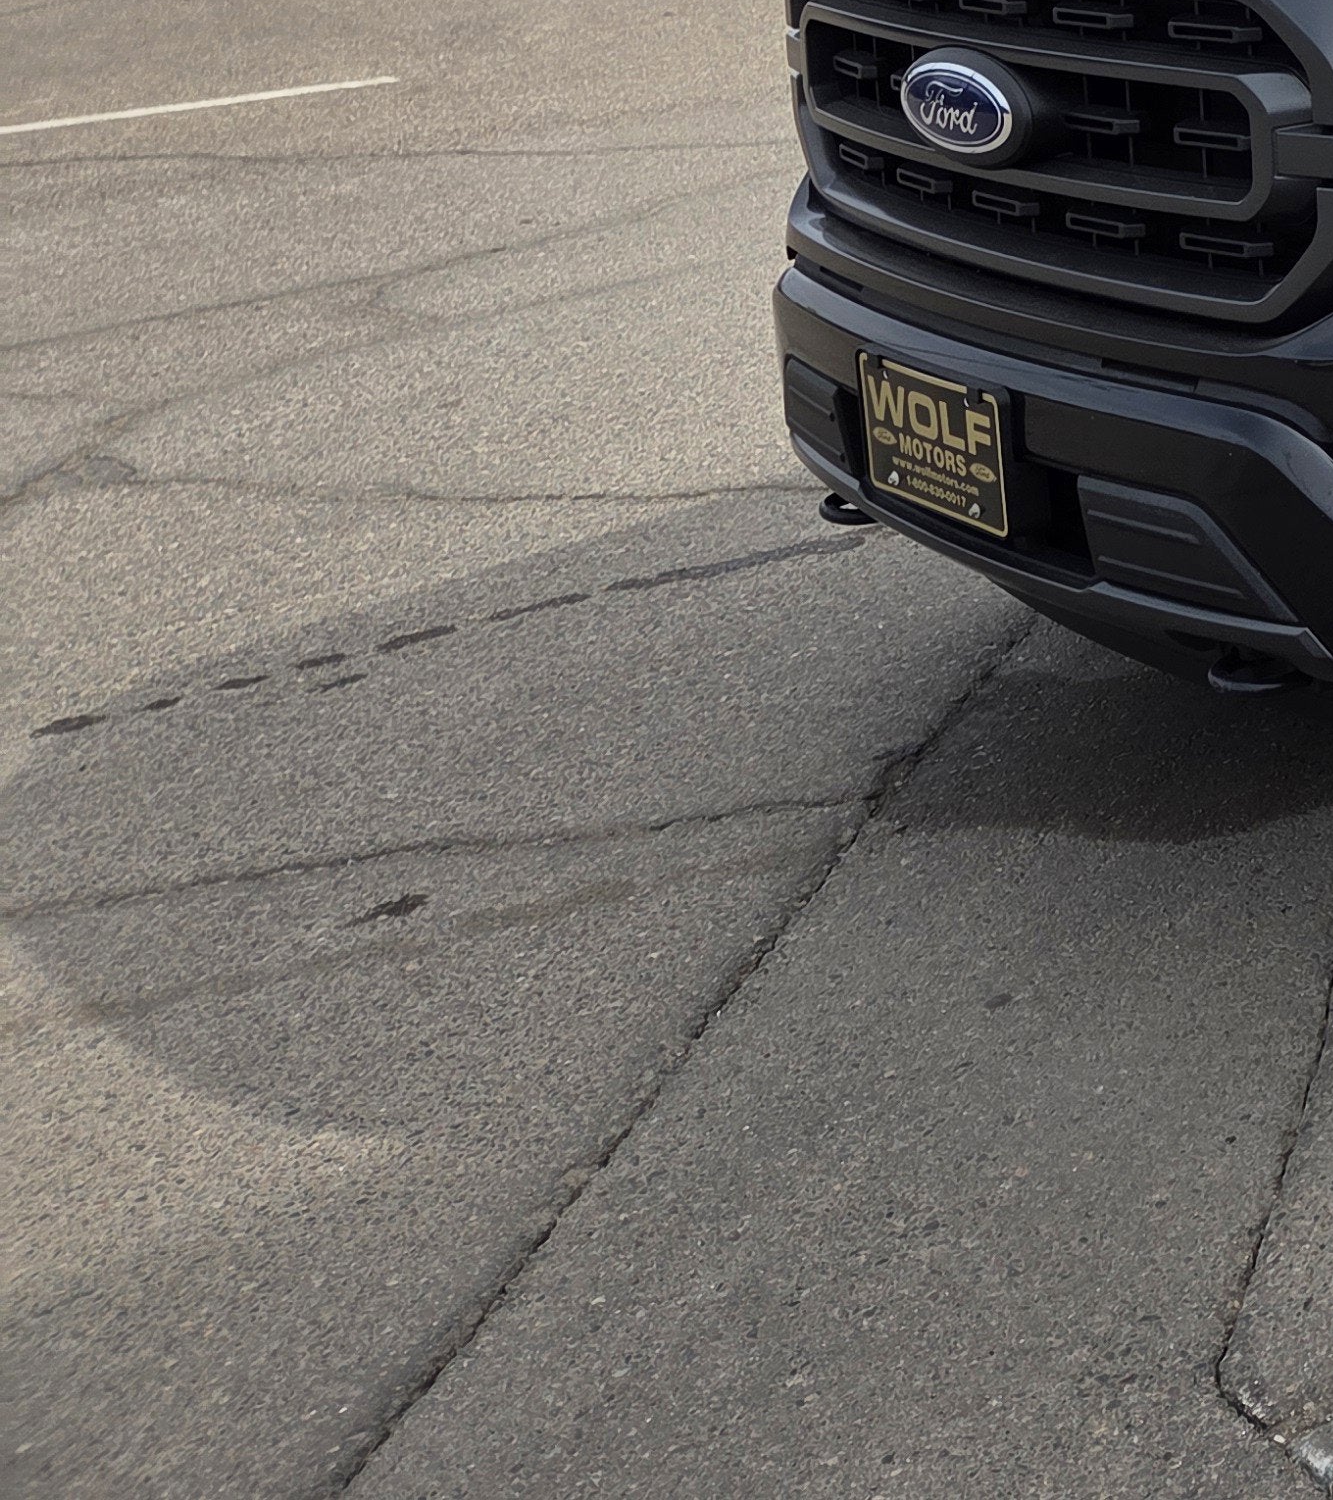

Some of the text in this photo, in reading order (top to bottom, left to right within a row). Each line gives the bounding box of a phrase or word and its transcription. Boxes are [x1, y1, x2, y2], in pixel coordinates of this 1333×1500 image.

[920, 80, 978, 135] Ford
[867, 374, 992, 456] WOLF
[899, 432, 968, 477] MOTORS
